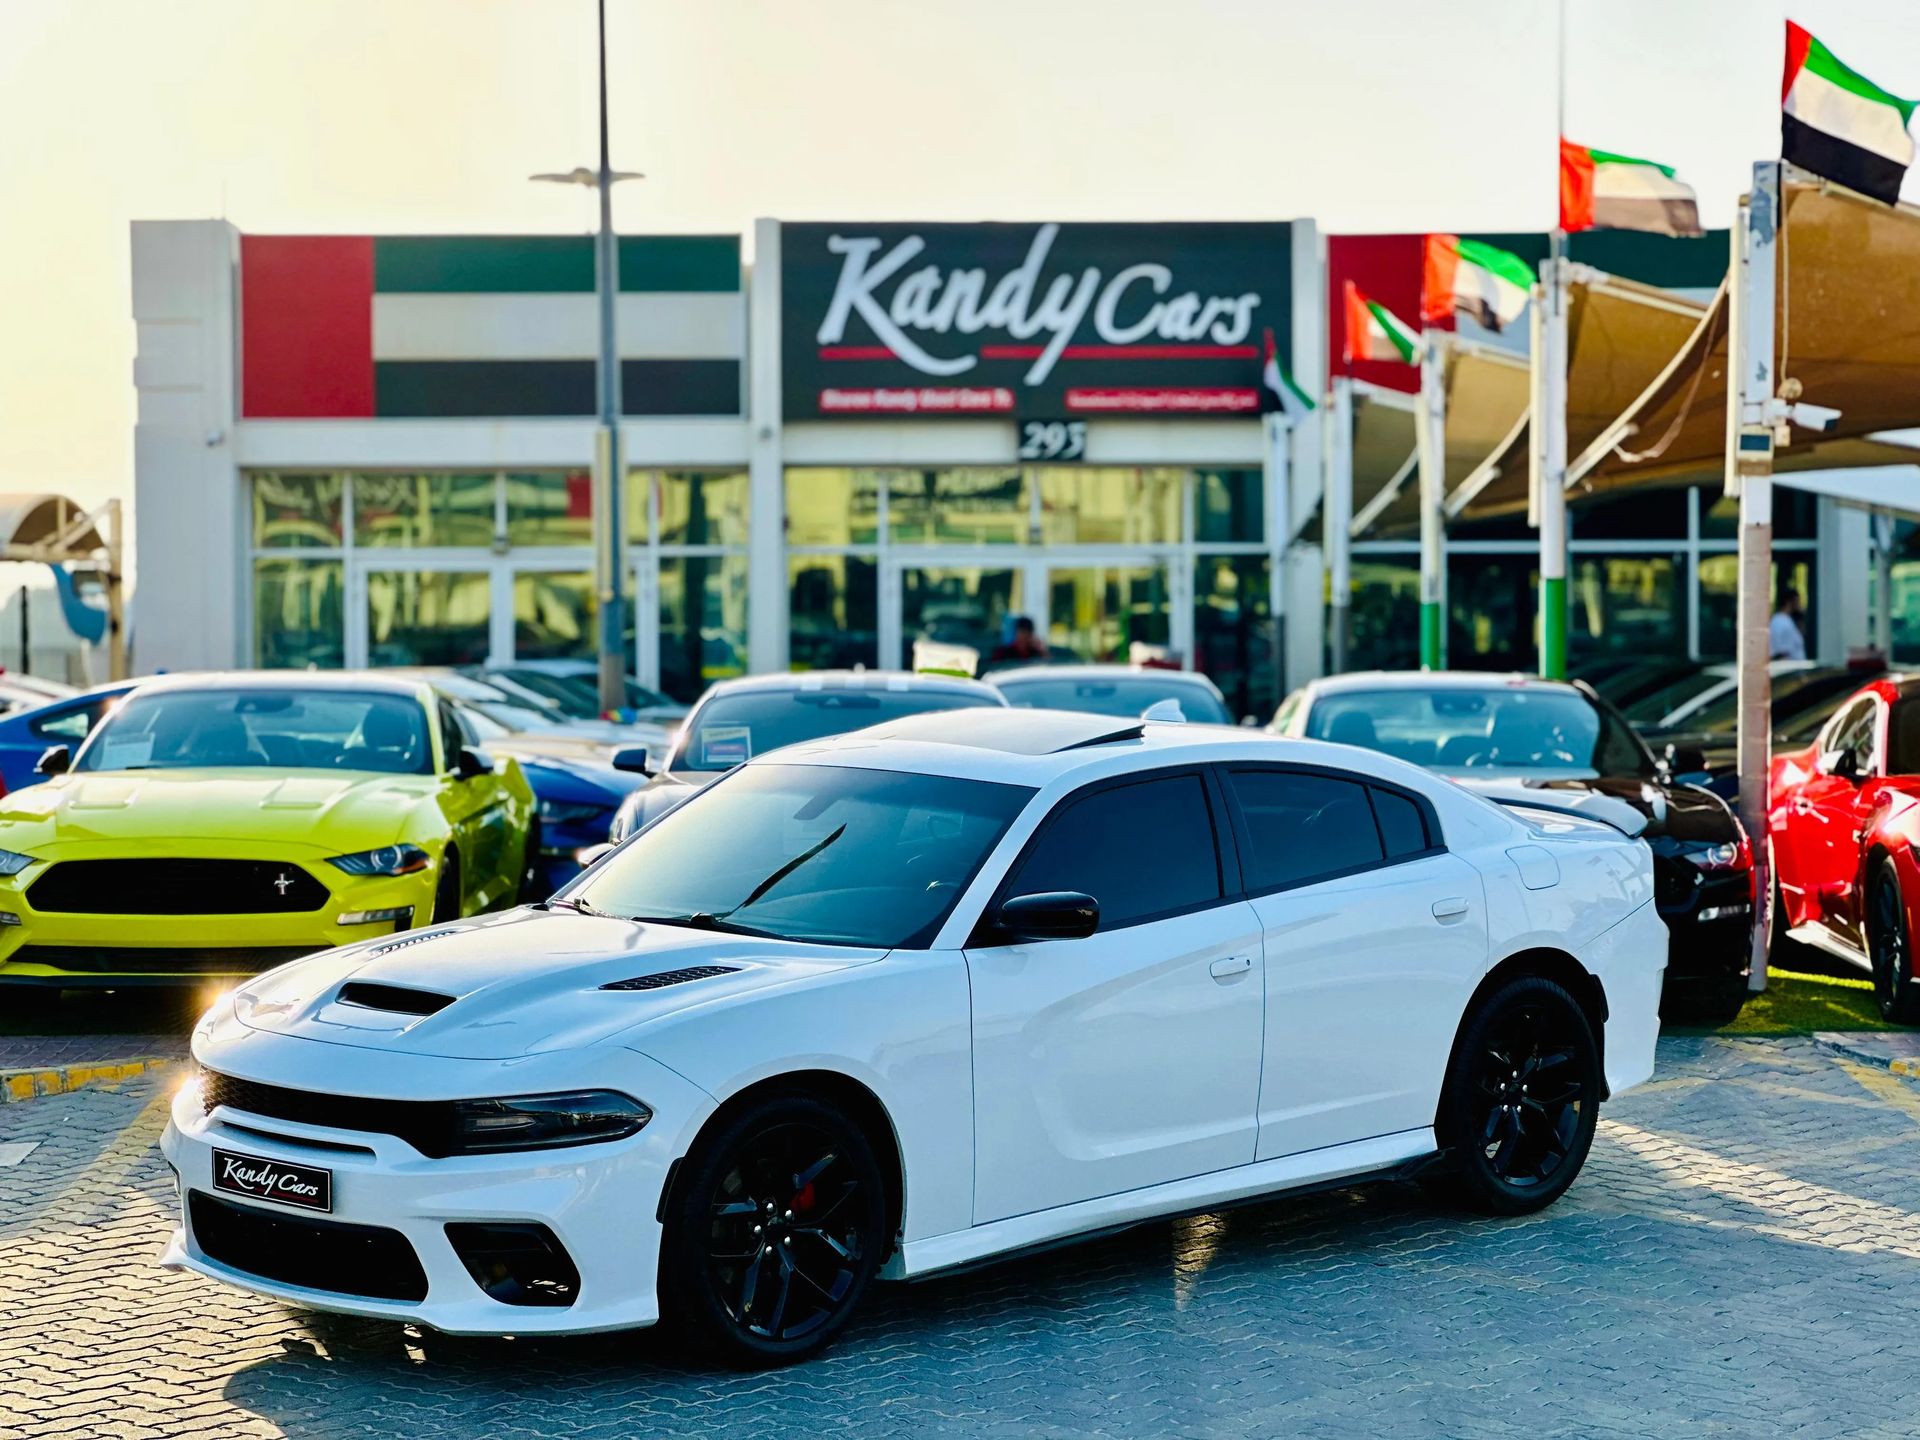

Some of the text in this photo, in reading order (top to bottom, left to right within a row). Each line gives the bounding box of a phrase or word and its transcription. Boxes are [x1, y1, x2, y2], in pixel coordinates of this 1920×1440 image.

[818, 223, 1260, 384] Kandy Cars
[223, 1157, 319, 1196] Kandy Cars
